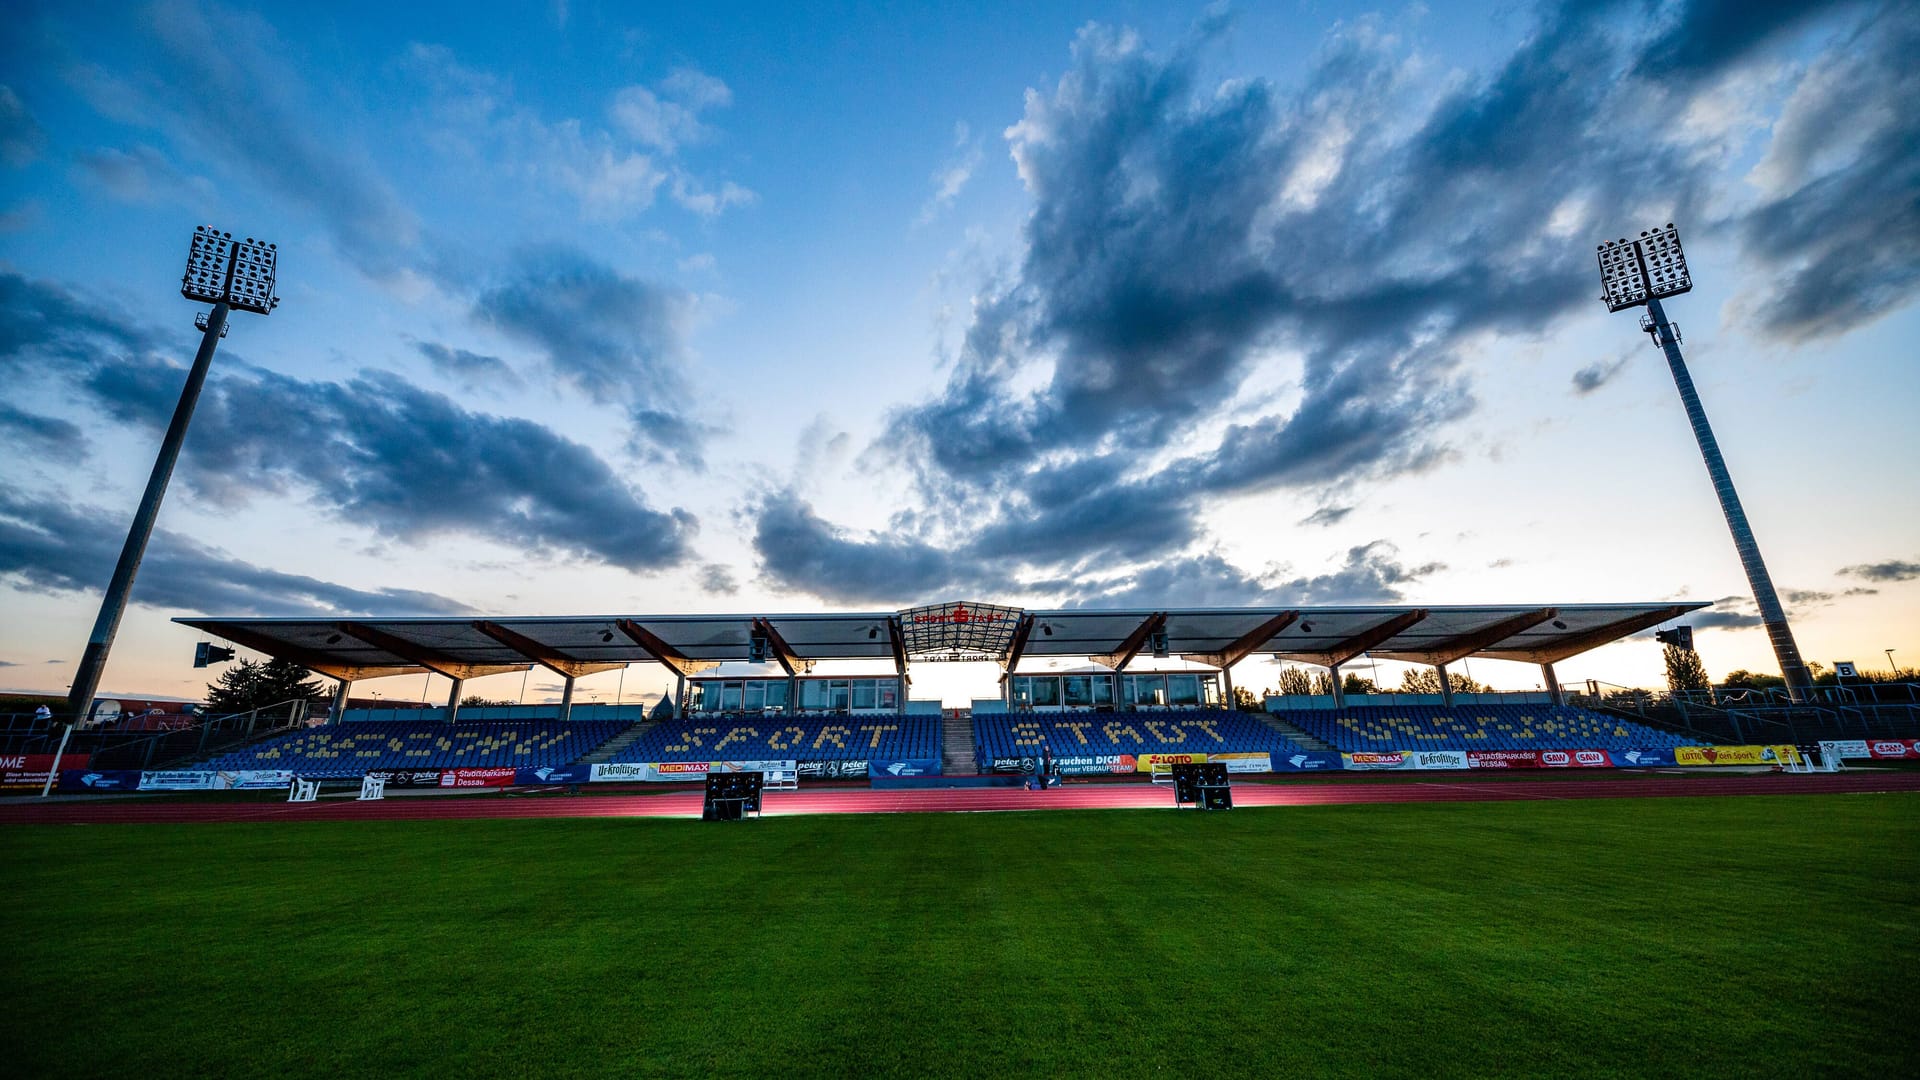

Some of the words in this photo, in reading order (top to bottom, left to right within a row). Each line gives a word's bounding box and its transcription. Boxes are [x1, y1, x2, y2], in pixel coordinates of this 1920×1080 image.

[1840, 666, 1852, 676] B
[1011, 720, 1225, 746] STADT
[665, 724, 898, 753] SPORT
[1877, 744, 1902, 753] SAW
[1059, 756, 1092, 766] suchen
[1095, 755, 1121, 765] DICH
[1162, 755, 1192, 764] LOTTO
[1353, 754, 1402, 764] MEDIMAX
[1478, 752, 1537, 761] STADTSPARKASSE
[1545, 753, 1567, 763] SAW
[1578, 753, 1601, 762] SAW
[1719, 752, 1732, 760] den
[1733, 751, 1755, 761] Sport.
[797, 761, 823, 770] peter
[841, 760, 868, 770] peter
[994, 758, 1020, 767] peter
[1480, 760, 1508, 768] DESSAU
[659, 763, 709, 773] MEDIMAX
[1082, 765, 1133, 773] VERKAUFSTEAM!
[412, 770, 440, 780] peter
[457, 769, 515, 779] Stadtsparkasse
[457, 778, 485, 786] Dessau
